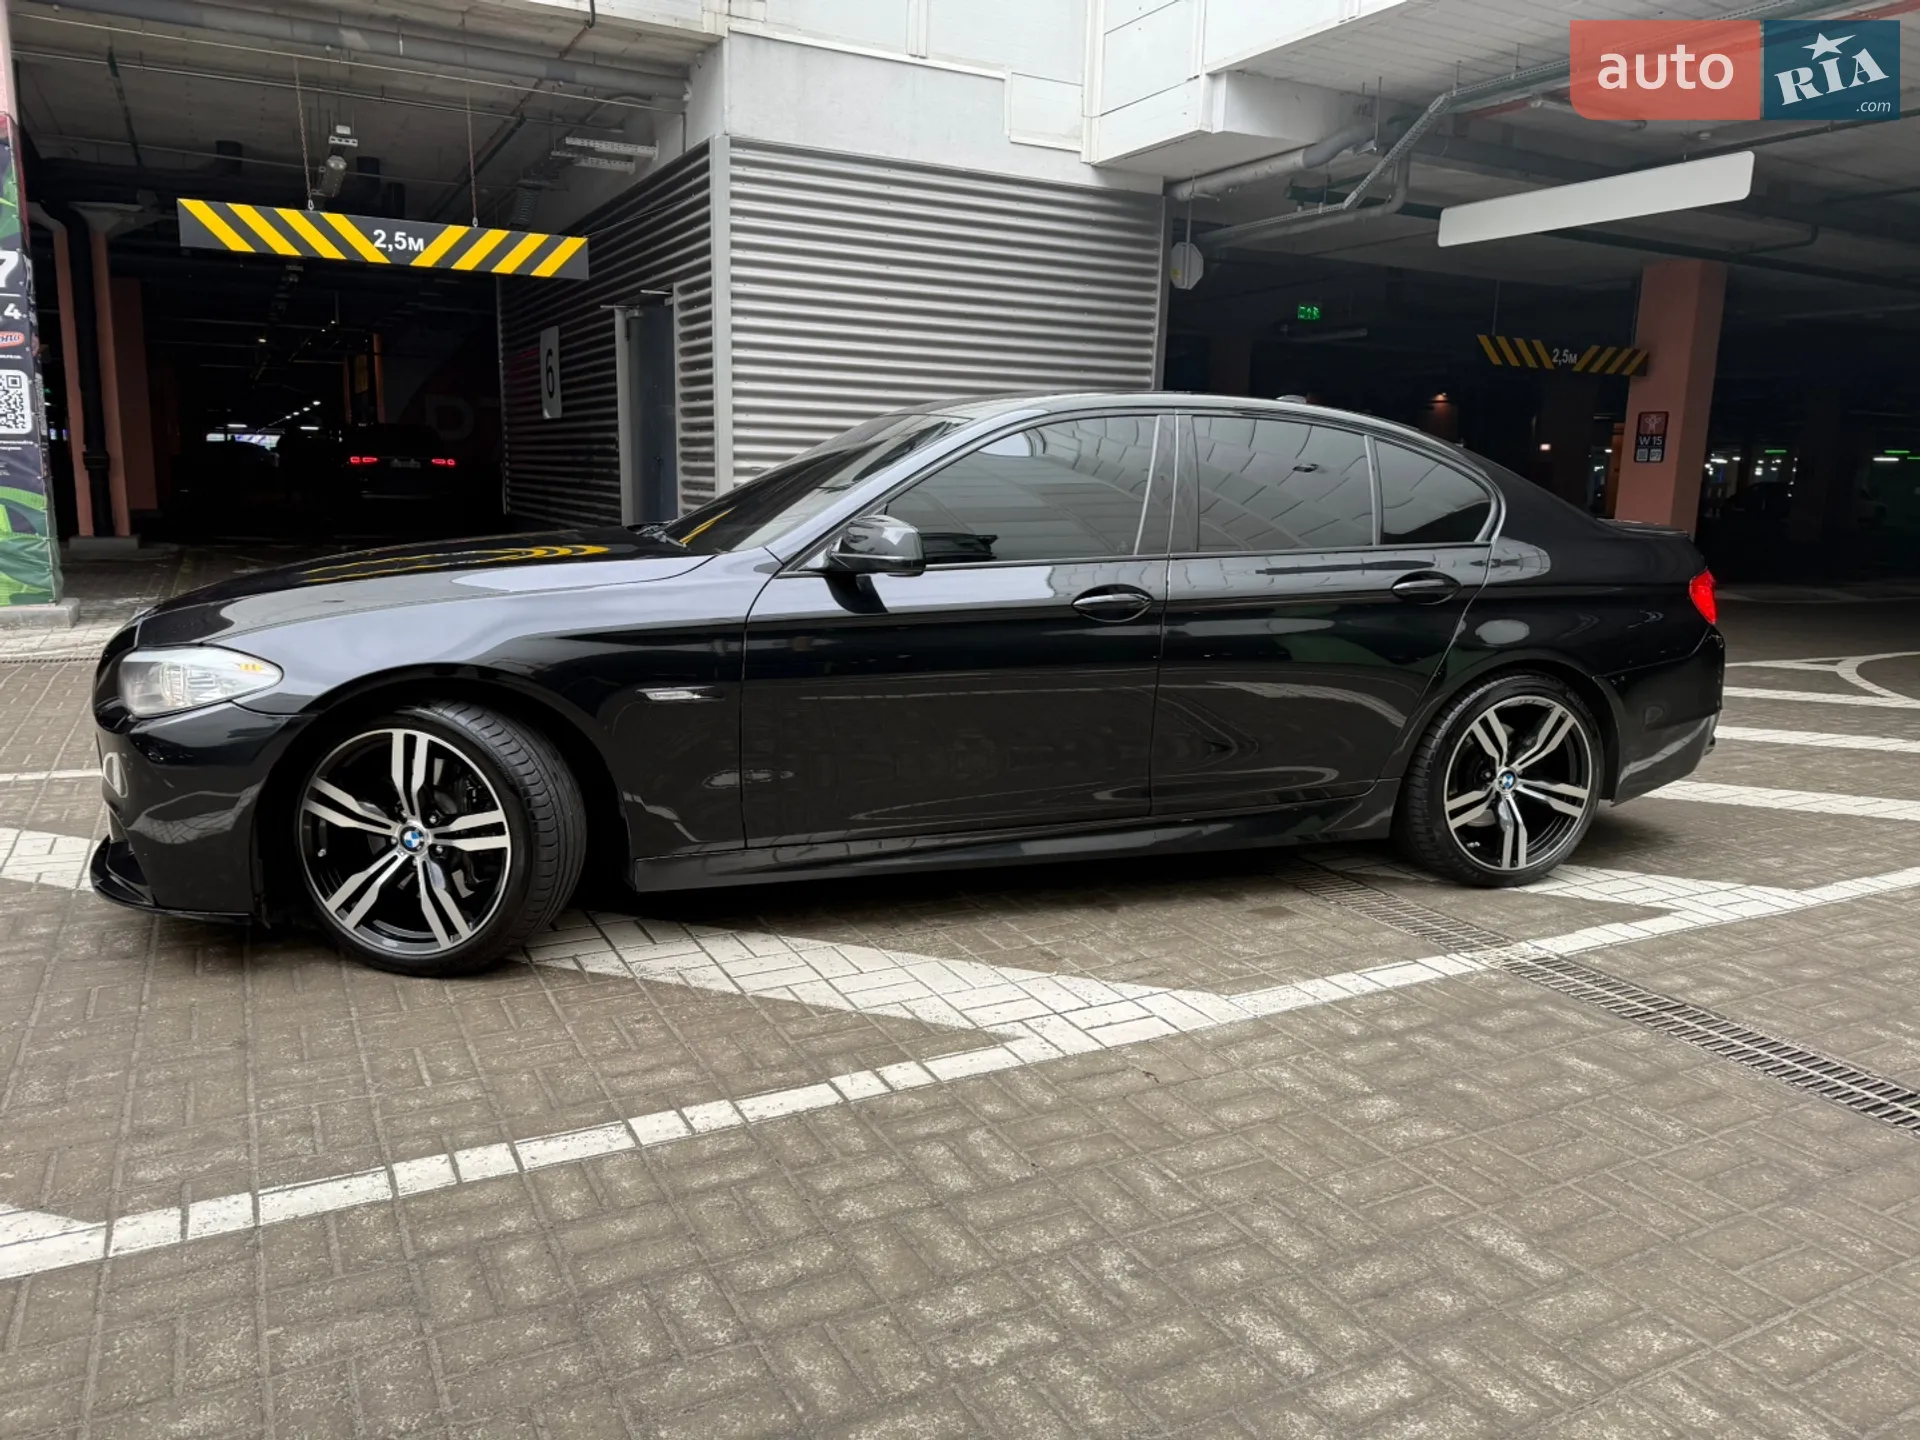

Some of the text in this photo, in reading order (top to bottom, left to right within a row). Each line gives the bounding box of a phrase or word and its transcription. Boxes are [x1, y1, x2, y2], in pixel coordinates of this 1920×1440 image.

[545, 348, 555, 399] 6
[1639, 435, 1663, 445] W 15
